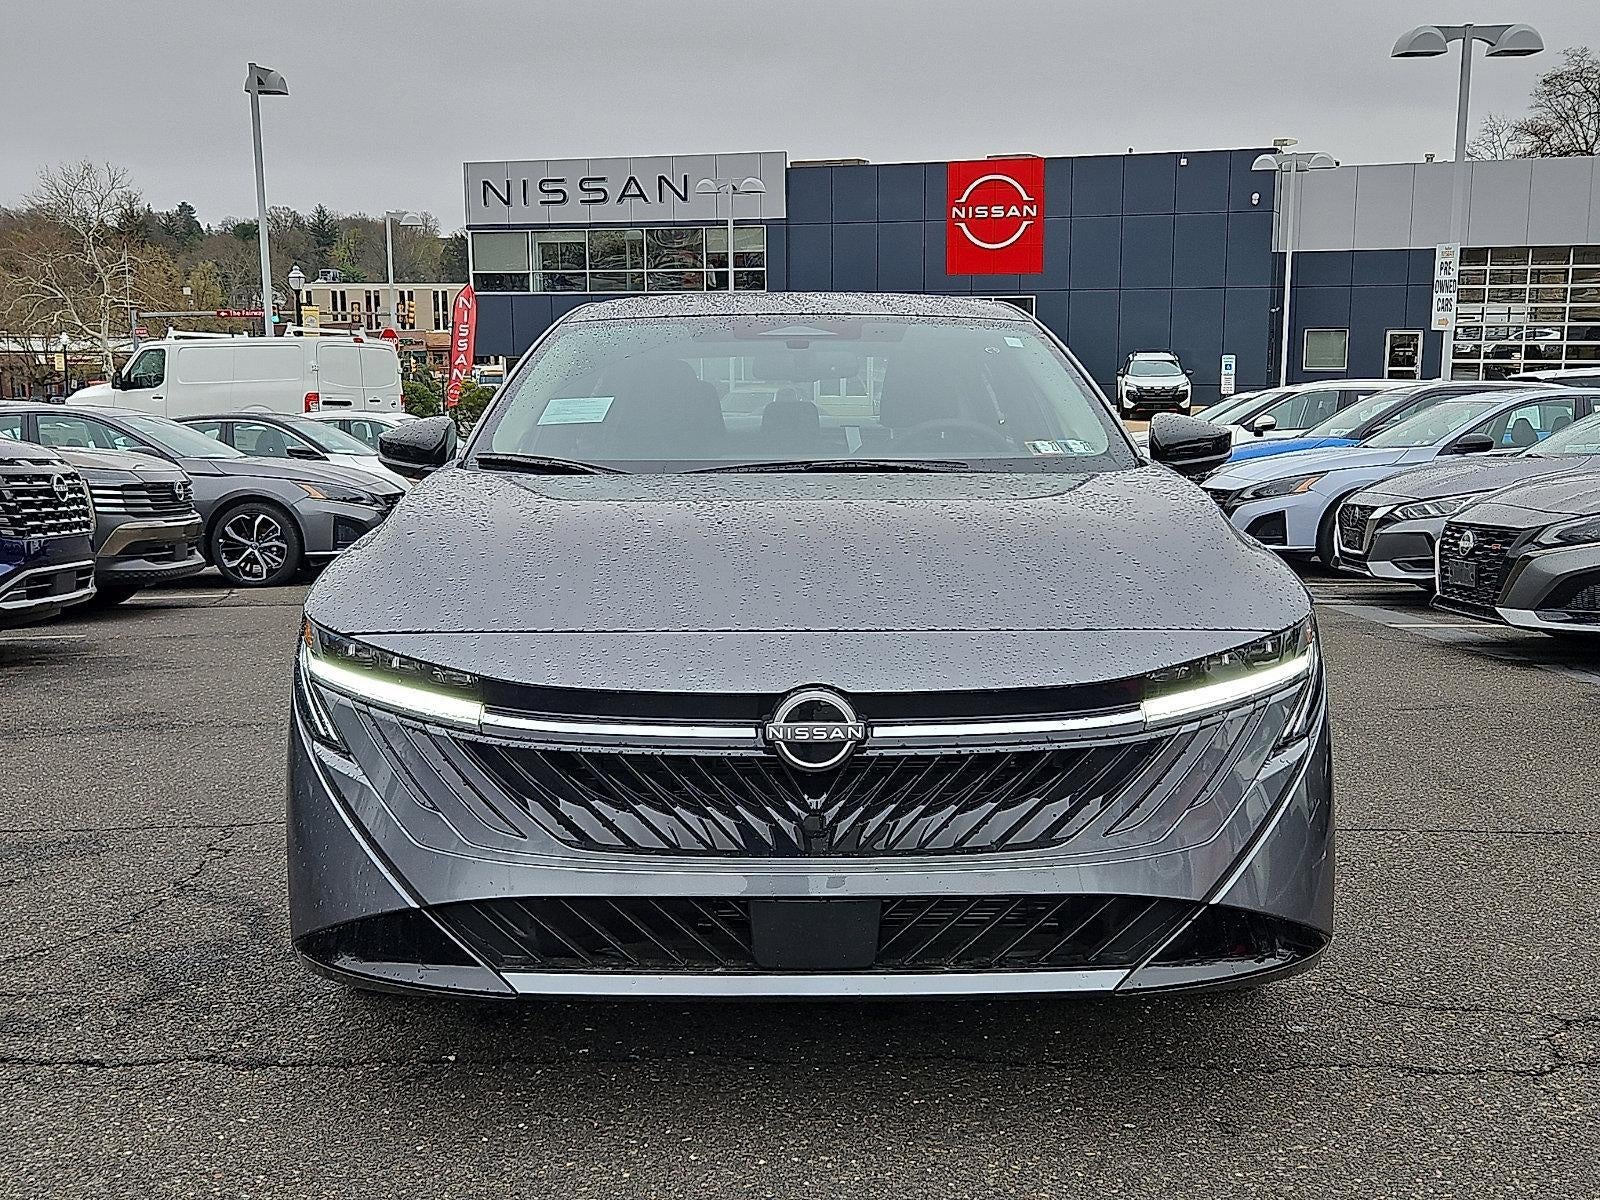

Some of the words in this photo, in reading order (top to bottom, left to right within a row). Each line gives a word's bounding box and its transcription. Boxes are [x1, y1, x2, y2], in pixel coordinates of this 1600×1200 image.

[481, 174, 690, 207] NISSAN
[951, 204, 1038, 219] NISSAN
[1440, 261, 1455, 276] PRE-
[1435, 279, 1457, 295] OWNED
[1436, 297, 1453, 313] CARS
[230, 309, 240, 317] The
[451, 296, 472, 381] NISSAN
[767, 726, 863, 741] NISSAN
